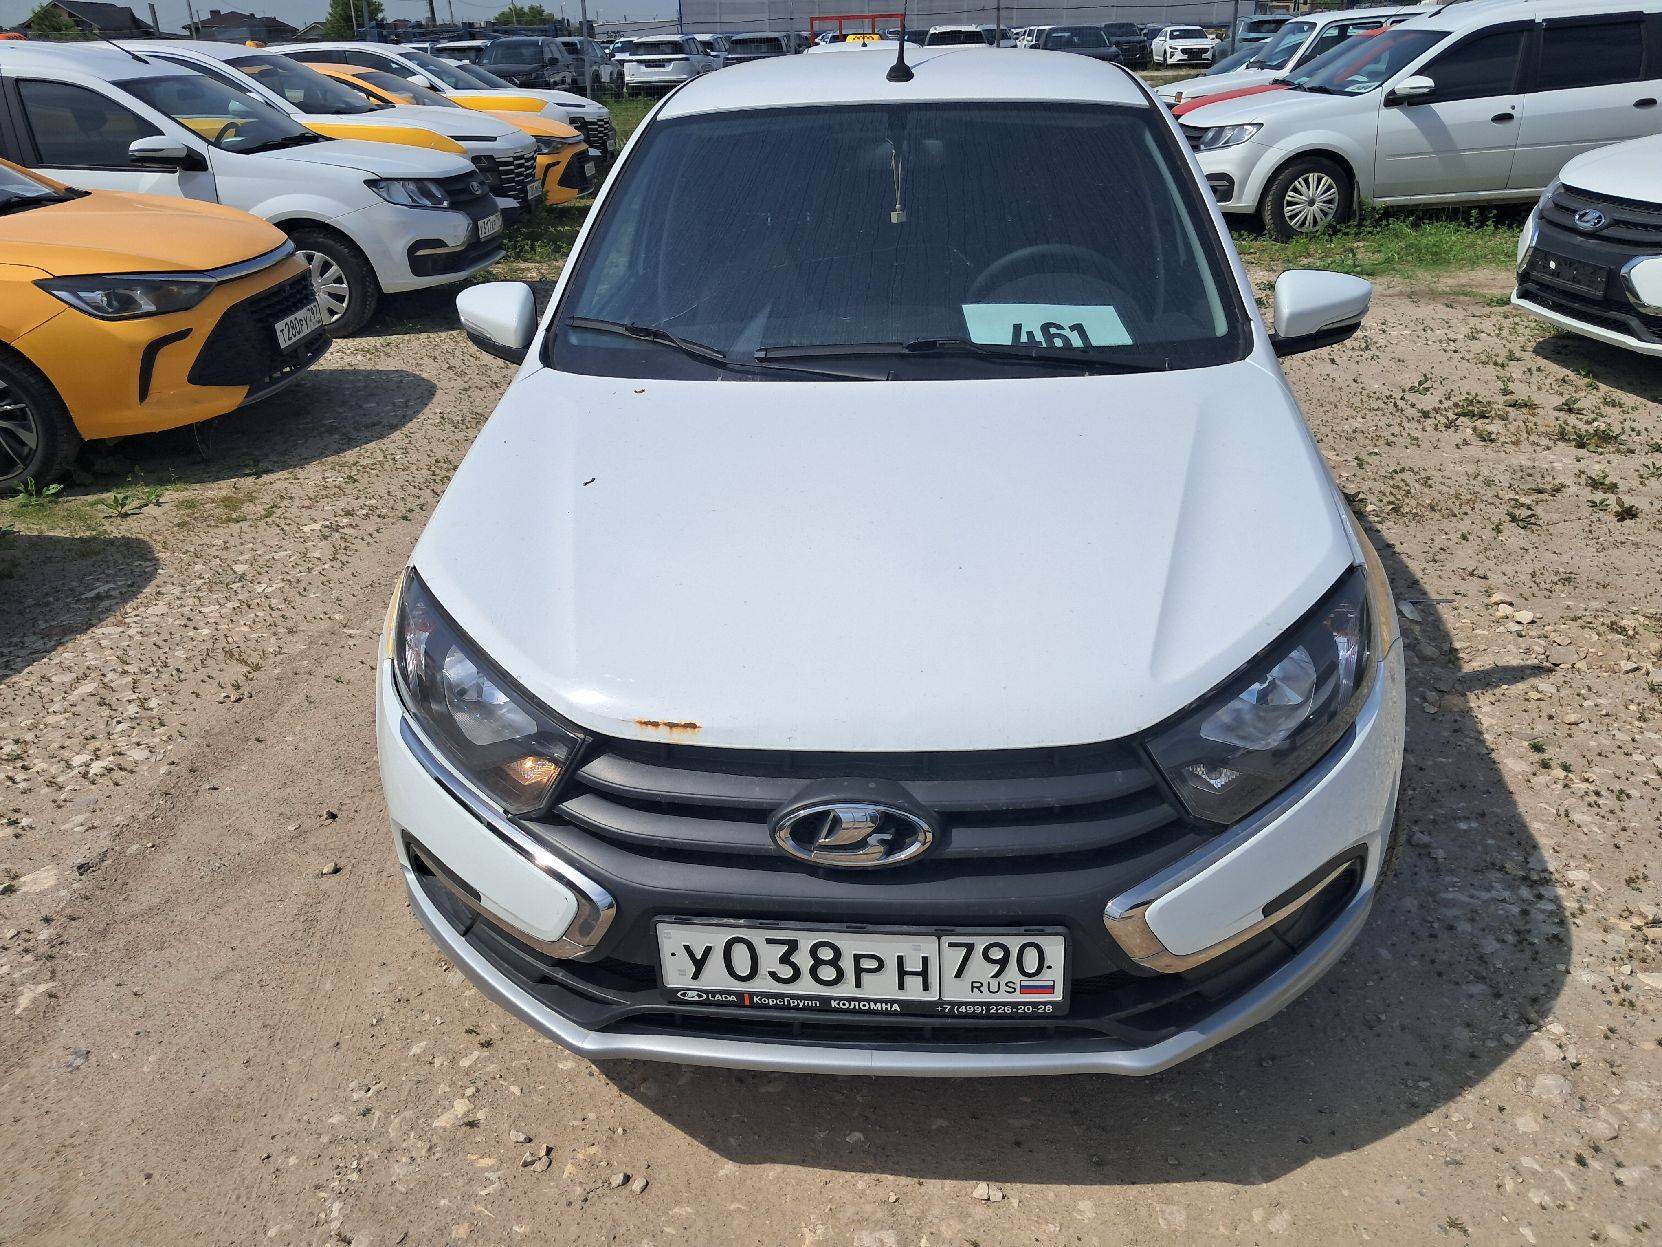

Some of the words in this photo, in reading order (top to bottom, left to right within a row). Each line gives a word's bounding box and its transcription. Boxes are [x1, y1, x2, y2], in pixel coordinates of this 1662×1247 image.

[1011, 321, 1093, 352] 461
[947, 941, 1046, 979] 790
[970, 980, 1017, 995] RUS
[708, 992, 738, 1003] LADA
[753, 994, 820, 1008] КорсГрупп
[830, 998, 901, 1012] КОЛОМНА
[935, 1004, 951, 1014] +7
[953, 1004, 987, 1015] (499)
[989, 1004, 1053, 1014] 226-20-28
